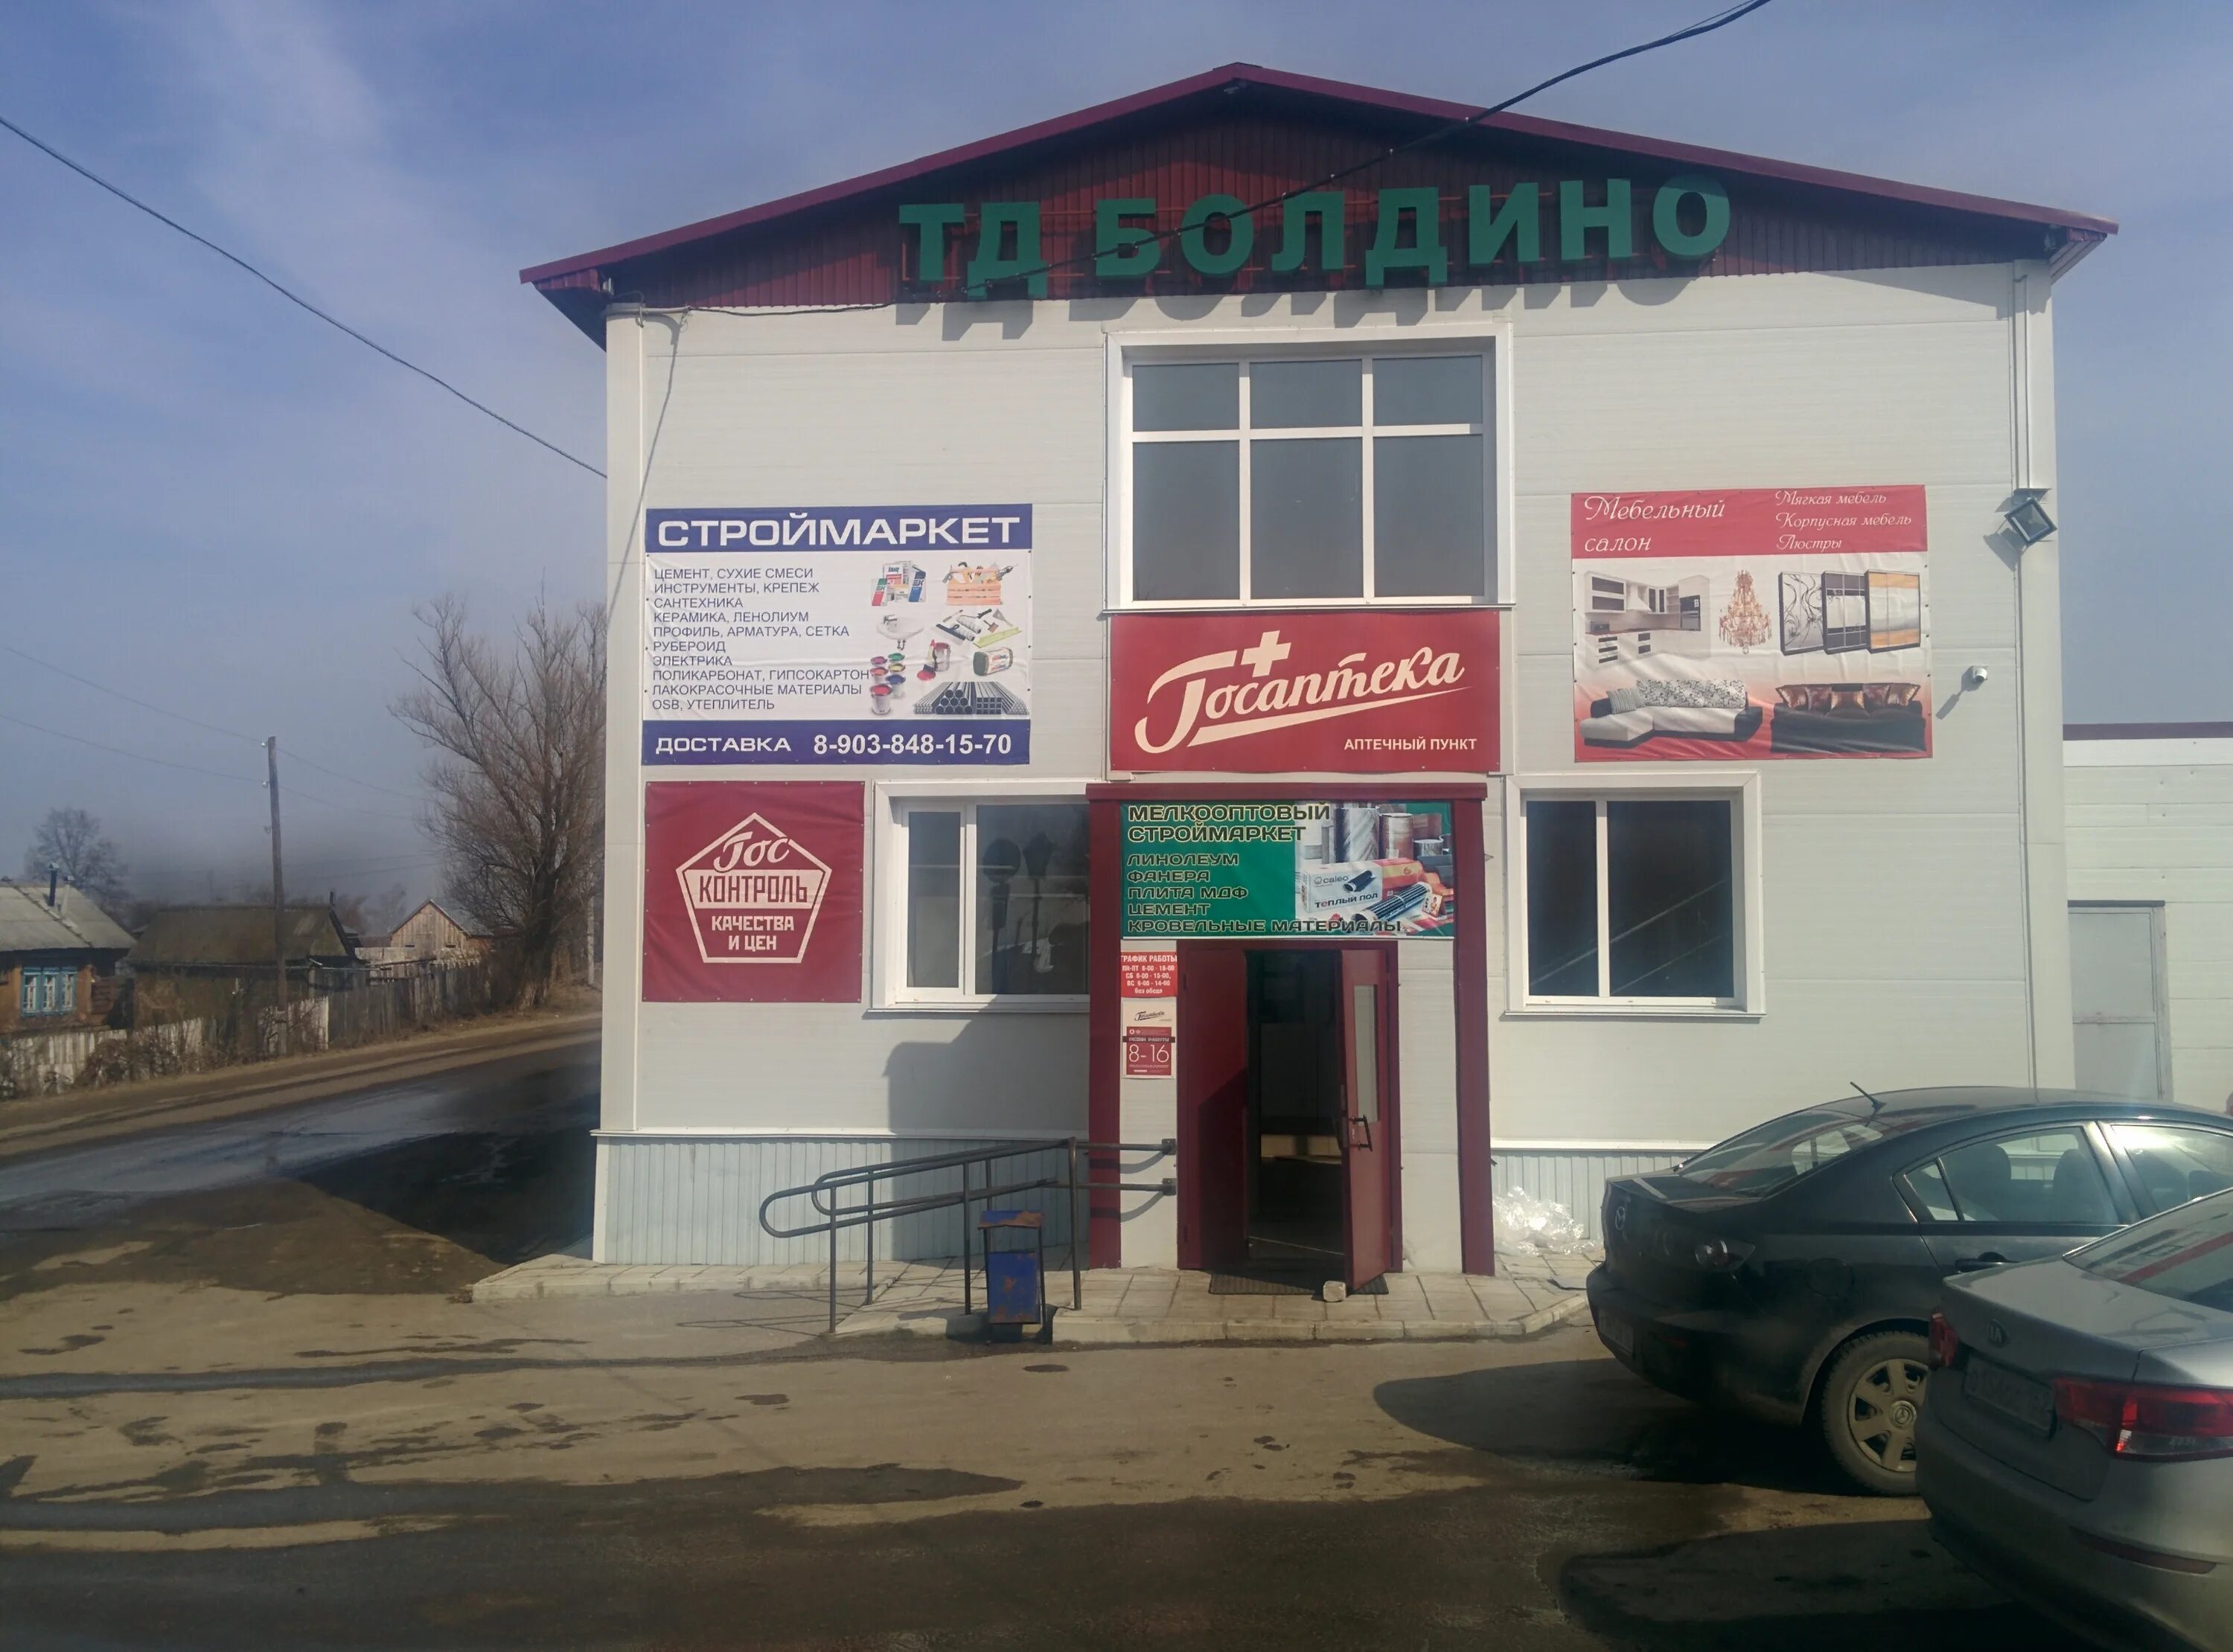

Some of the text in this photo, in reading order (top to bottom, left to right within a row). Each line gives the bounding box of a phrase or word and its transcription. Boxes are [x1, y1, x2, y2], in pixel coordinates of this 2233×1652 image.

[899, 174, 1731, 297] ТД БОЛДИНО
[1775, 490, 1887, 506] Мягкая мебель
[1585, 496, 1725, 520] Мебельный
[1775, 511, 1911, 528] Корпусная мебель
[658, 512, 1020, 546] СТРОЙМАРКЕТ
[1585, 537, 1651, 552] салон
[1776, 534, 1842, 551] Люстры
[654, 567, 814, 580] ЦЕМЕНТ, СУХИЕ СМЕСИ
[654, 581, 820, 595] ИНСТРУМЕНТЫ, КРЕПЕЖ
[654, 597, 744, 609] САНТЕХНИКА
[654, 610, 810, 624] КЕРАМИКА, ЛЕНОЛИУМ
[654, 625, 849, 639] ПРОФИЛЬ, АРМАТУРА, СЕТКА
[653, 640, 726, 654] РУБЕРОИД
[653, 655, 732, 667] ЭЛЕКТРИКА
[652, 669, 869, 682] ПОЛИКАРБОНАТ, ГИПСОКАРТОН
[652, 683, 862, 697] ЛАКОКРАСОЧНЫЕ МАТЕРИАЛЫ
[652, 698, 775, 712] OSB, УТЕПЛИТЕЛЬ
[1134, 646, 1466, 754] Госаптека
[656, 734, 1012, 755] ДОСТАВКА 8-903-848-15-70
[1344, 736, 1478, 751] АПТЕЧНЫЙ ПУНКТ
[1128, 801, 1331, 822] МЕЛКООПТОВЫЙ
[1128, 822, 1306, 843] СТРОЙМАРКЕТ
[713, 831, 790, 872] Гос
[1127, 854, 1239, 867] ЛИНОЛЕУМ
[1127, 870, 1210, 883] ФАНЕРА
[699, 875, 808, 903] КОНТРОЛЬ
[1127, 886, 1248, 899] ПЛИТА МДФ
[1128, 903, 1211, 916] ЦЕМЕНТ
[712, 915, 795, 931] КАЧЕСТВА
[1127, 919, 1402, 933] КРОВЕЛЬНЫЕ МАТЕРИАЛЫ
[728, 935, 777, 952] И ЦЕН
